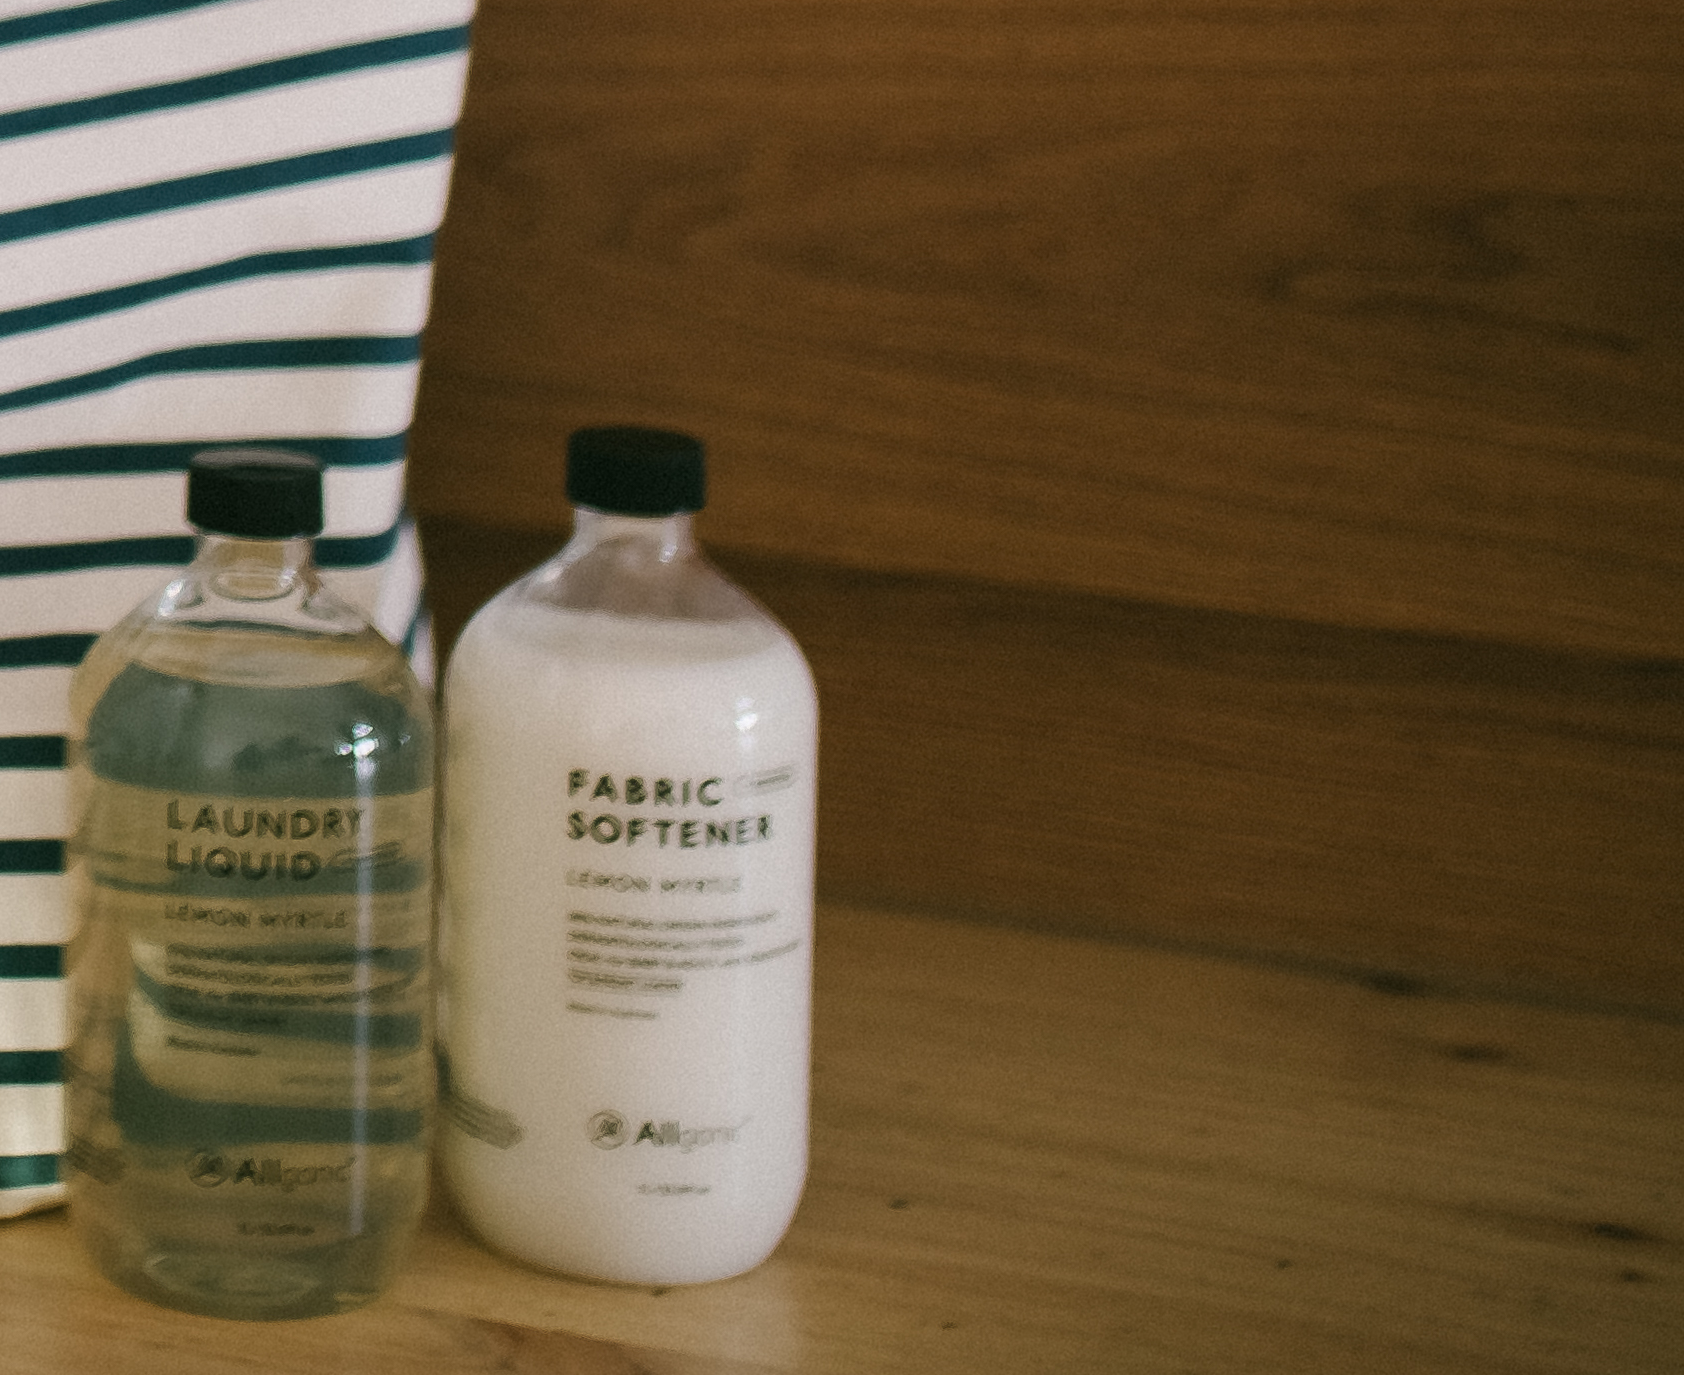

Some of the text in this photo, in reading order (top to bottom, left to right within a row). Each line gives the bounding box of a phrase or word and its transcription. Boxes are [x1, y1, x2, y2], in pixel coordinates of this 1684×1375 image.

[567, 768, 725, 808] FABRIC
[165, 799, 365, 841] LAUNDRY
[566, 810, 774, 849] SOFTENER
[165, 841, 322, 882] LIQUID
